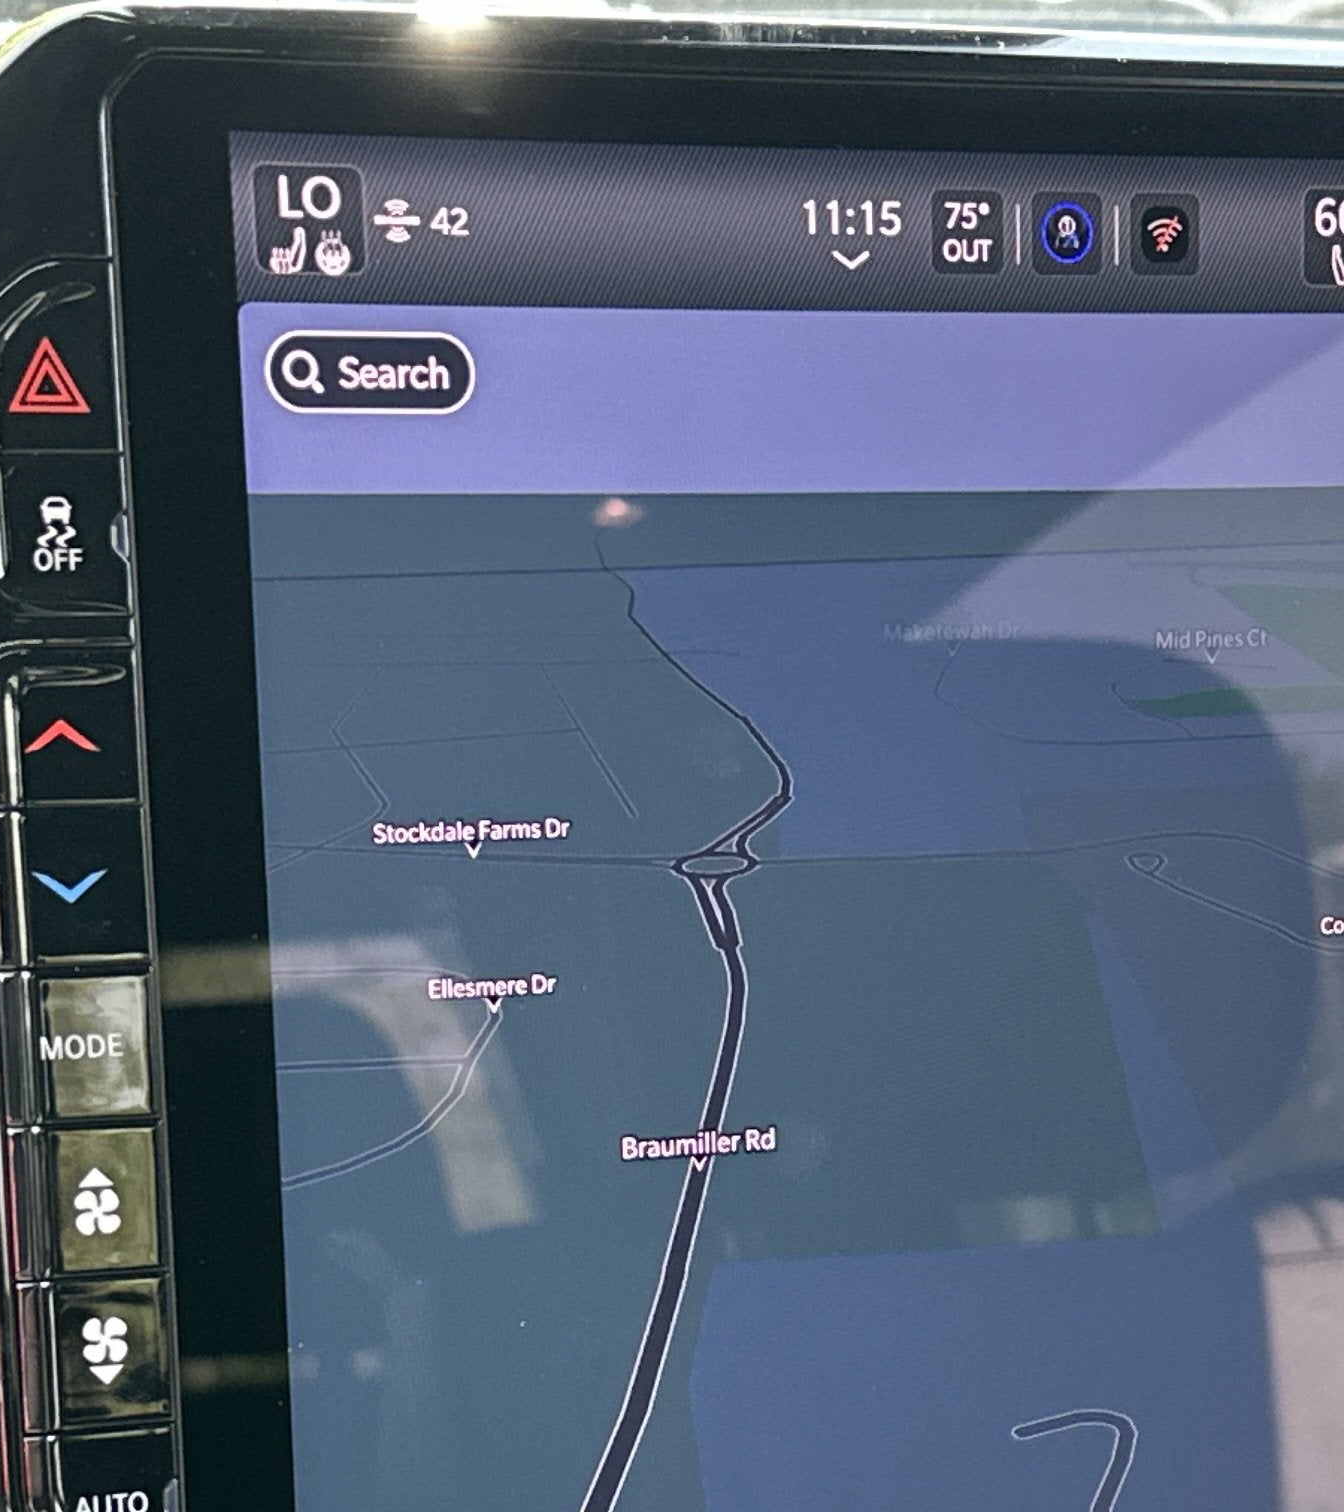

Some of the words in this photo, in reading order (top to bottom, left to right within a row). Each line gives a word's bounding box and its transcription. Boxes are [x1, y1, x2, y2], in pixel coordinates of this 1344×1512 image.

[276, 174, 342, 219] LO
[429, 207, 470, 237] 42
[803, 199, 902, 238] 11:15
[944, 201, 989, 231] 75°
[943, 238, 992, 264] OUT
[338, 355, 450, 391] Search
[33, 548, 83, 572] OFF
[1155, 630, 1191, 650] Mid
[1195, 629, 1244, 649] Pines
[1247, 628, 1268, 647] Ct
[372, 821, 475, 845] Stockdale
[478, 819, 543, 842] Farms
[545, 818, 570, 838] Dr
[428, 977, 529, 1000] Ellesmere
[531, 974, 556, 995] Dr
[40, 1034, 124, 1061] MODE
[621, 1132, 742, 1161] Braumiller
[744, 1127, 777, 1153] Rd
